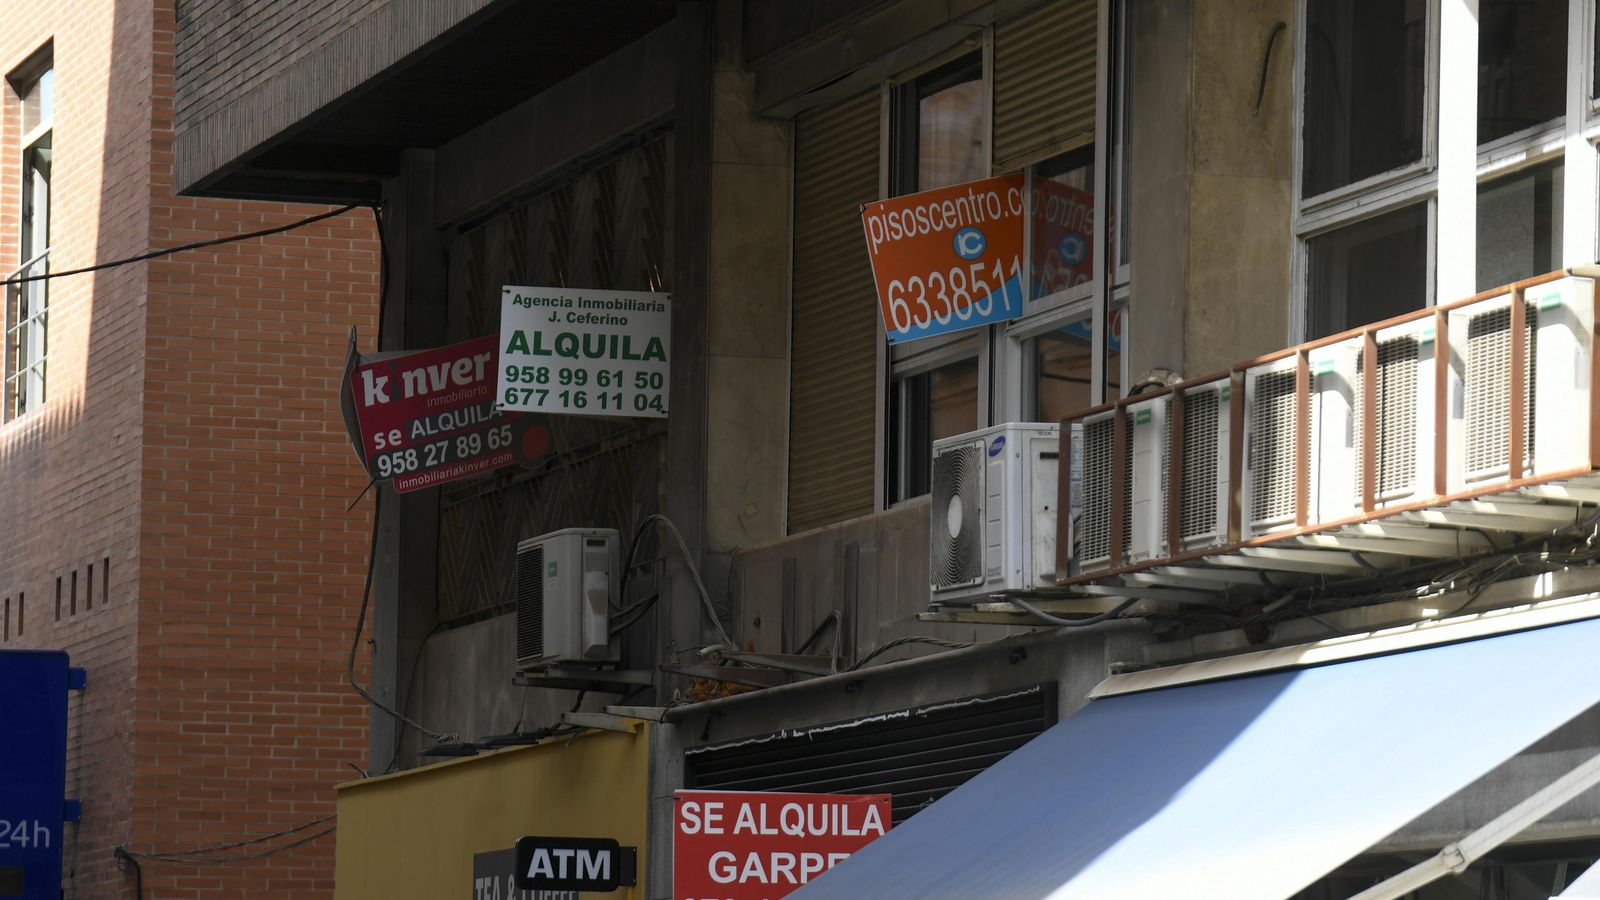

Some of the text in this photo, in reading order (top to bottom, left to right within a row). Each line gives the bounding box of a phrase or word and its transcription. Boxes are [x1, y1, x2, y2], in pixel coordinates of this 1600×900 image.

[512, 293, 665, 312] Agencia Inmobiliaria
[548, 310, 628, 326] J. Ceferino
[505, 330, 668, 362] ALQUILA
[361, 350, 491, 407] kinver
[505, 365, 664, 389] 958 99 61 50
[426, 384, 487, 408] inmobiliaria
[504, 387, 664, 412] 677 16 11 04
[374, 400, 503, 450] se ALQUILA
[377, 424, 513, 478] 958 27 89 65
[398, 452, 513, 489] inmobiliariakinver.com
[679, 801, 886, 838] SE ALQUILA
[527, 848, 611, 881] ATM
